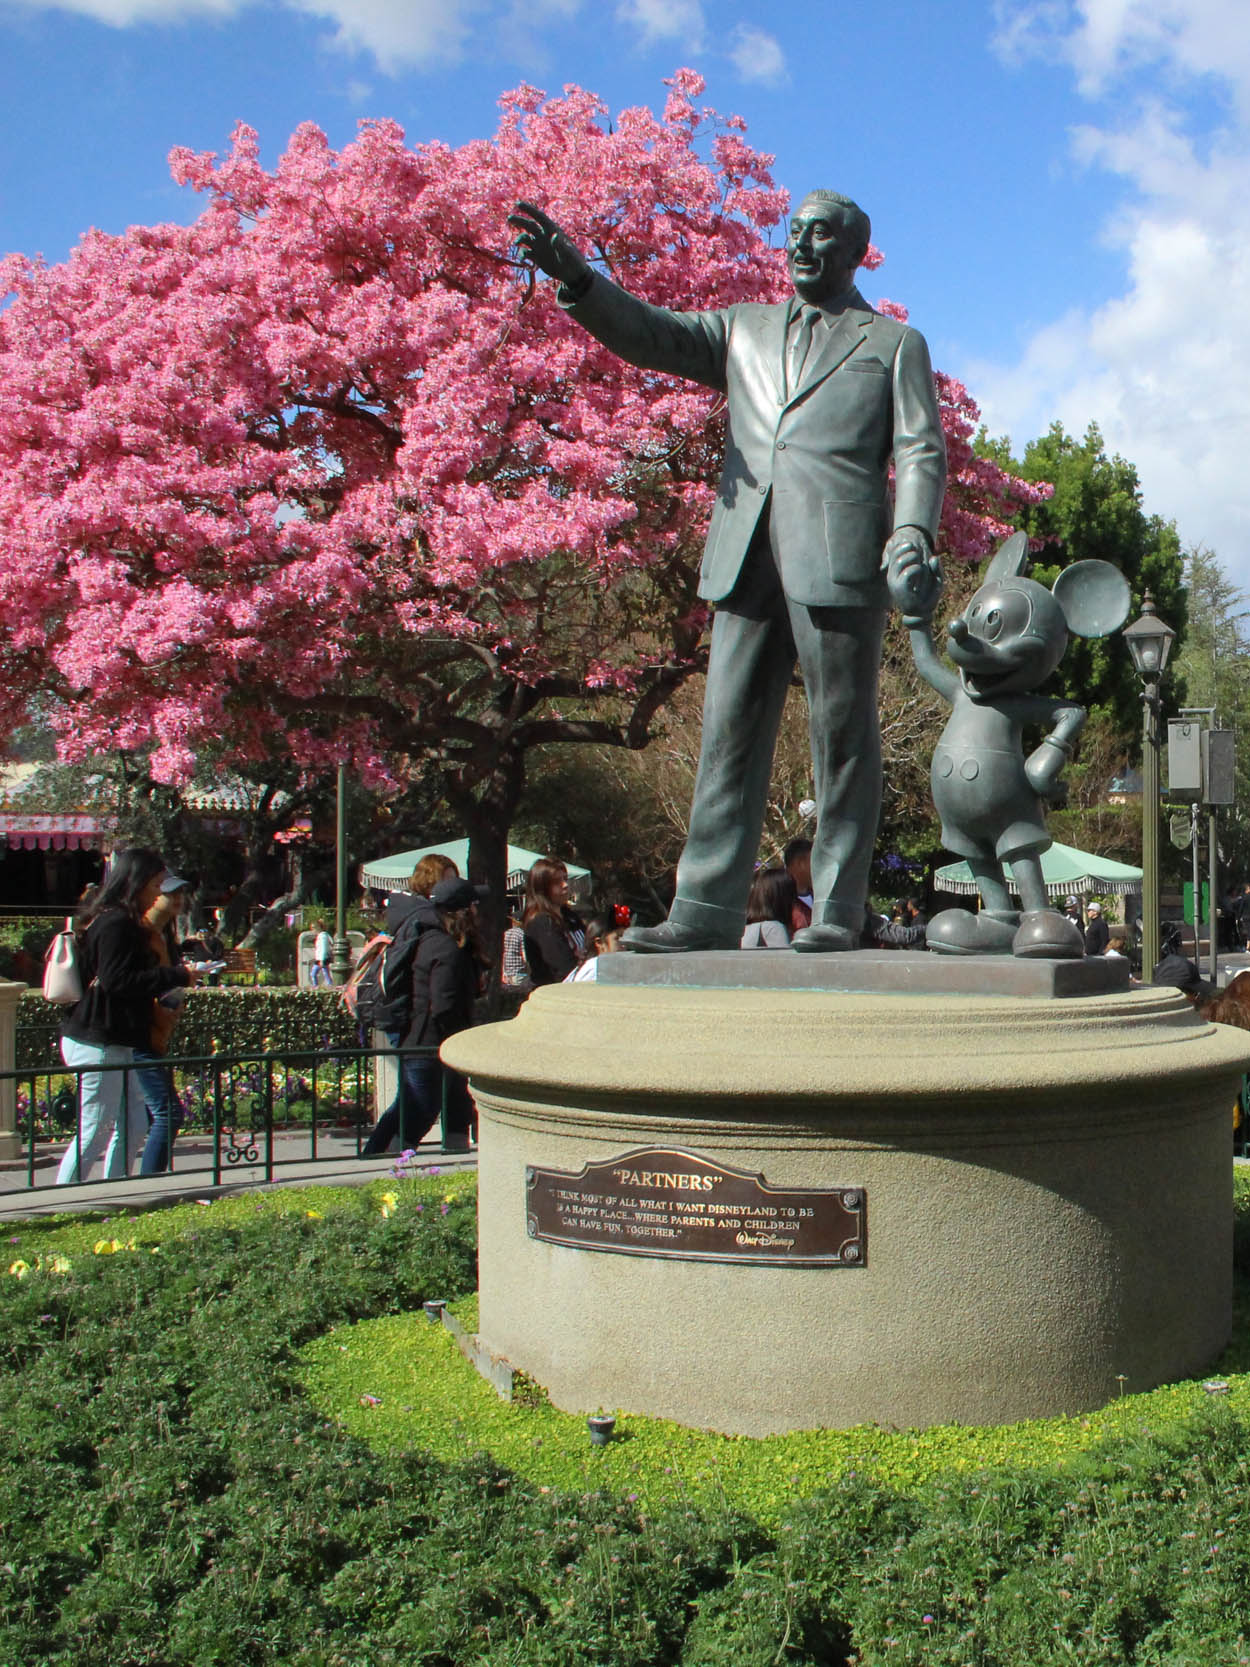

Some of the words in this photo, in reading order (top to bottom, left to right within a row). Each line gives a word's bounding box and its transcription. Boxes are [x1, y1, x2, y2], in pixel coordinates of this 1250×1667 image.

[557, 1190, 580, 1201] THINK
[581, 1193, 603, 1204] MOST
[606, 1196, 618, 1206] OF
[619, 1197, 637, 1208] ALL
[639, 1199, 666, 1210] WHAT
[669, 1202, 673, 1211] I
[676, 1202, 705, 1213] WANT
[708, 1204, 777, 1217] DISNEYLAND
[780, 1207, 796, 1217] TO
[799, 1208, 815, 1217] BE
[561, 1216, 578, 1226] CAN
[580, 1219, 602, 1230] HAVE
[565, 1204, 571, 1213] A
[572, 1205, 599, 1217] HAPPY
[670, 1215, 716, 1227] PARENTS
[718, 1218, 741, 1229] AND
[744, 1219, 800, 1231] CHILDREN
[756, 1231, 795, 1250] Disney
